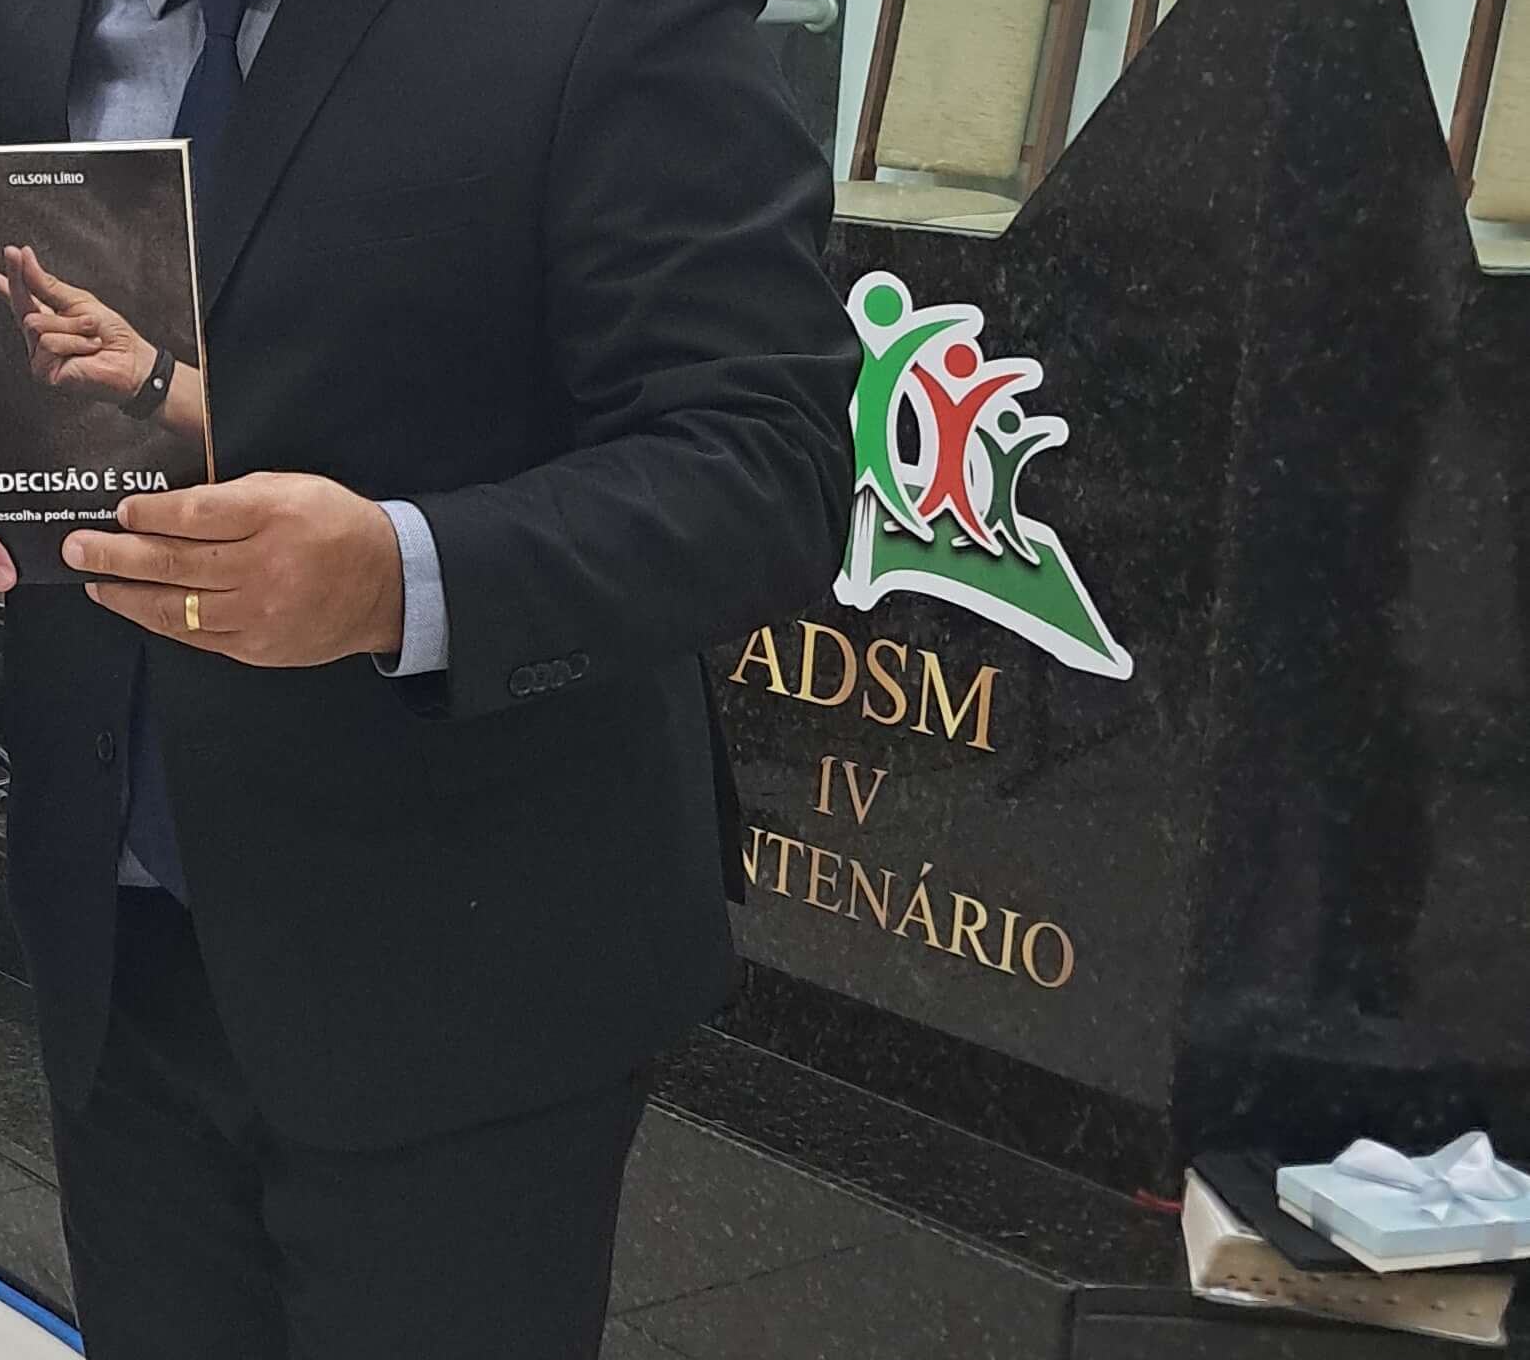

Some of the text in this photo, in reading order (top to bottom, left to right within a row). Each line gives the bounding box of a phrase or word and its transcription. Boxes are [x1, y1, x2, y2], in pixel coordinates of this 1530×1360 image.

[8, 170, 85, 185] GILSON LÍRIO
[103, 467, 118, 491] É
[122, 470, 169, 491] SUA
[44, 508, 76, 523] pode
[727, 619, 1003, 753] ADSM
[813, 755, 889, 826] IV
[742, 826, 1075, 990] NTENÁRIO
